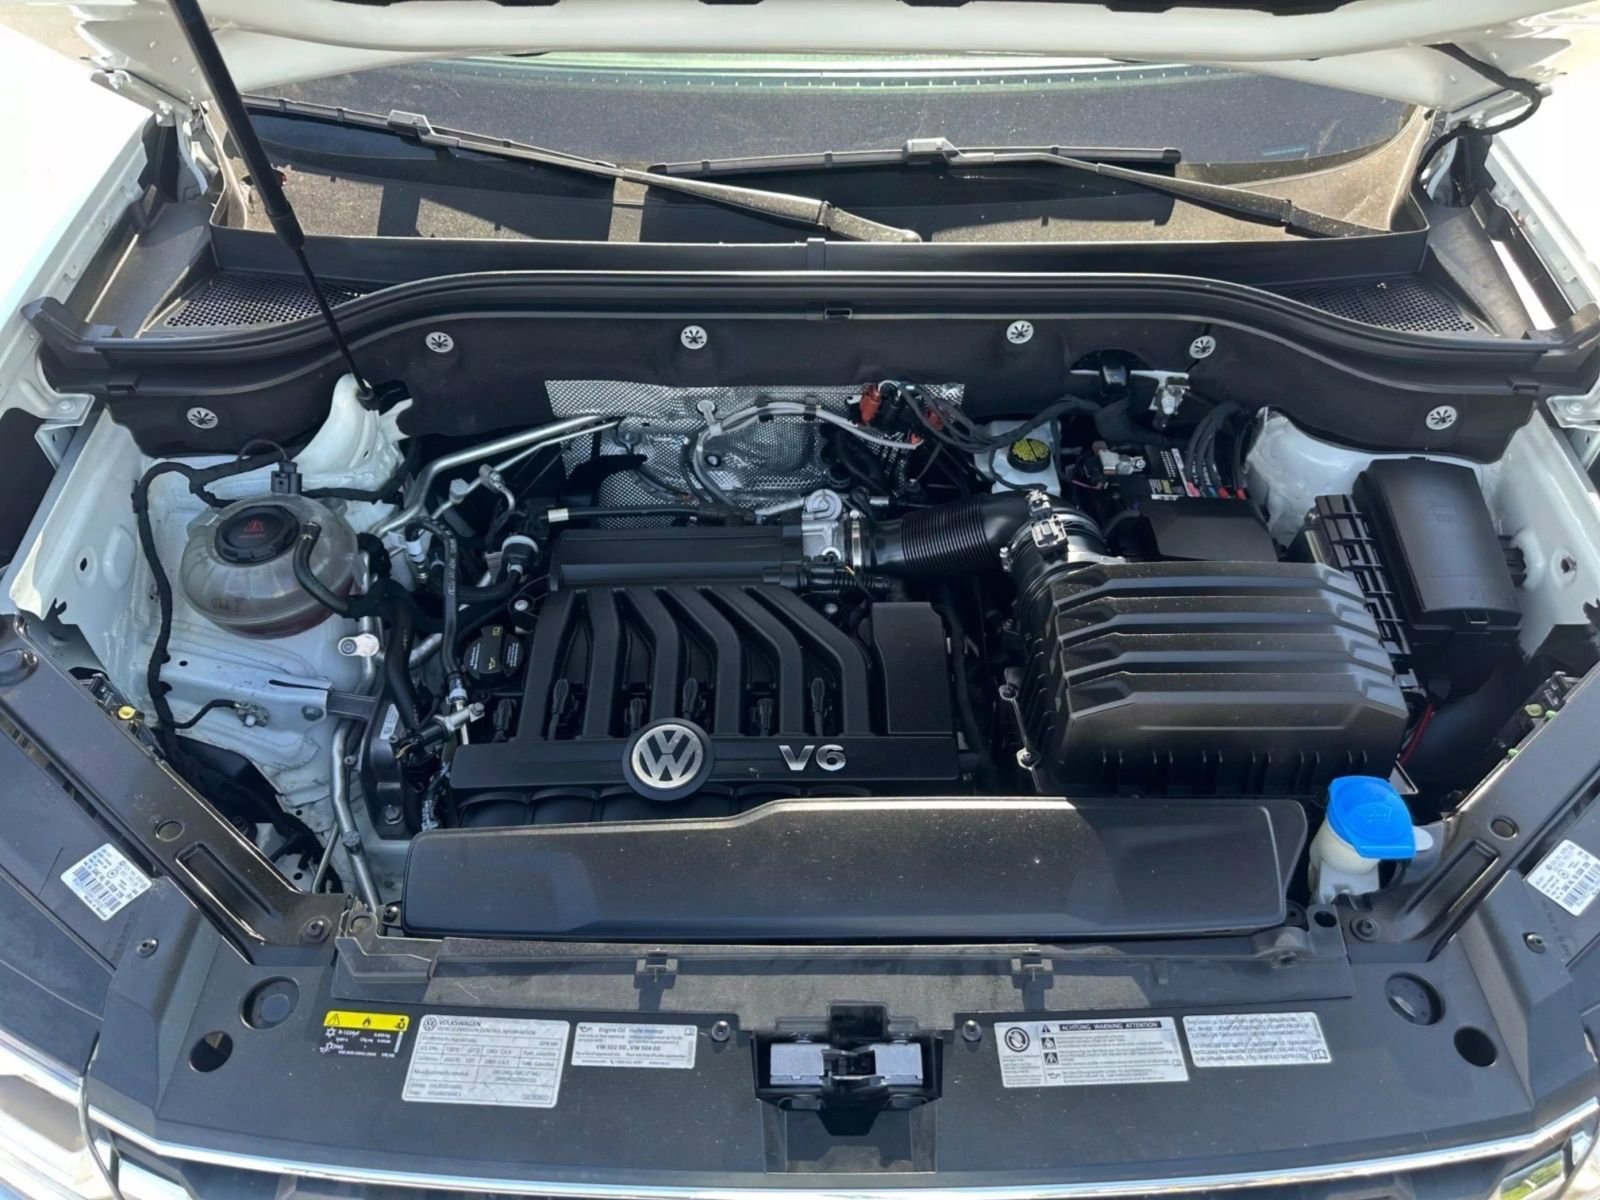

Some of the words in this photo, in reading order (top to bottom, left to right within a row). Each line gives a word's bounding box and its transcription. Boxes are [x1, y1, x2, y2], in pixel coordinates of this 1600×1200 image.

[632, 724, 703, 788] VW
[779, 744, 847, 772] V6
[439, 1020, 482, 1028] VOLKSWAGEN
[1093, 1022, 1123, 1030] WARNING
[1125, 1021, 1159, 1029] ATTENTION
